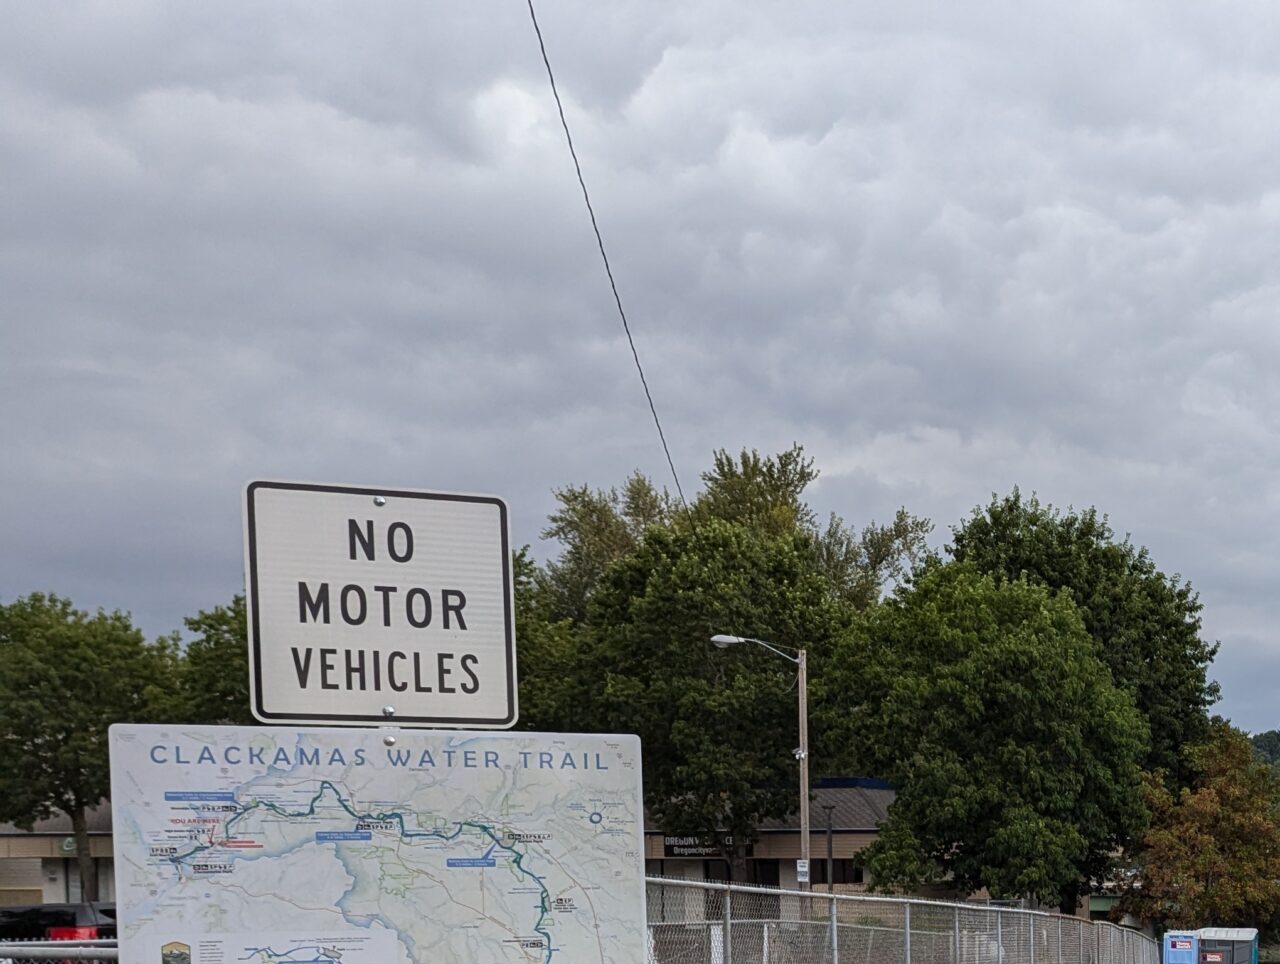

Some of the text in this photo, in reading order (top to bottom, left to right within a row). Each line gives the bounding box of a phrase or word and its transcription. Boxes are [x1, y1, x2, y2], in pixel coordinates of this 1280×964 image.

[348, 519, 414, 563] NO
[298, 581, 467, 630] MOTOR
[291, 647, 479, 694] VEHICLES
[150, 745, 609, 770] CLACKAMAS WATER TRAIL
